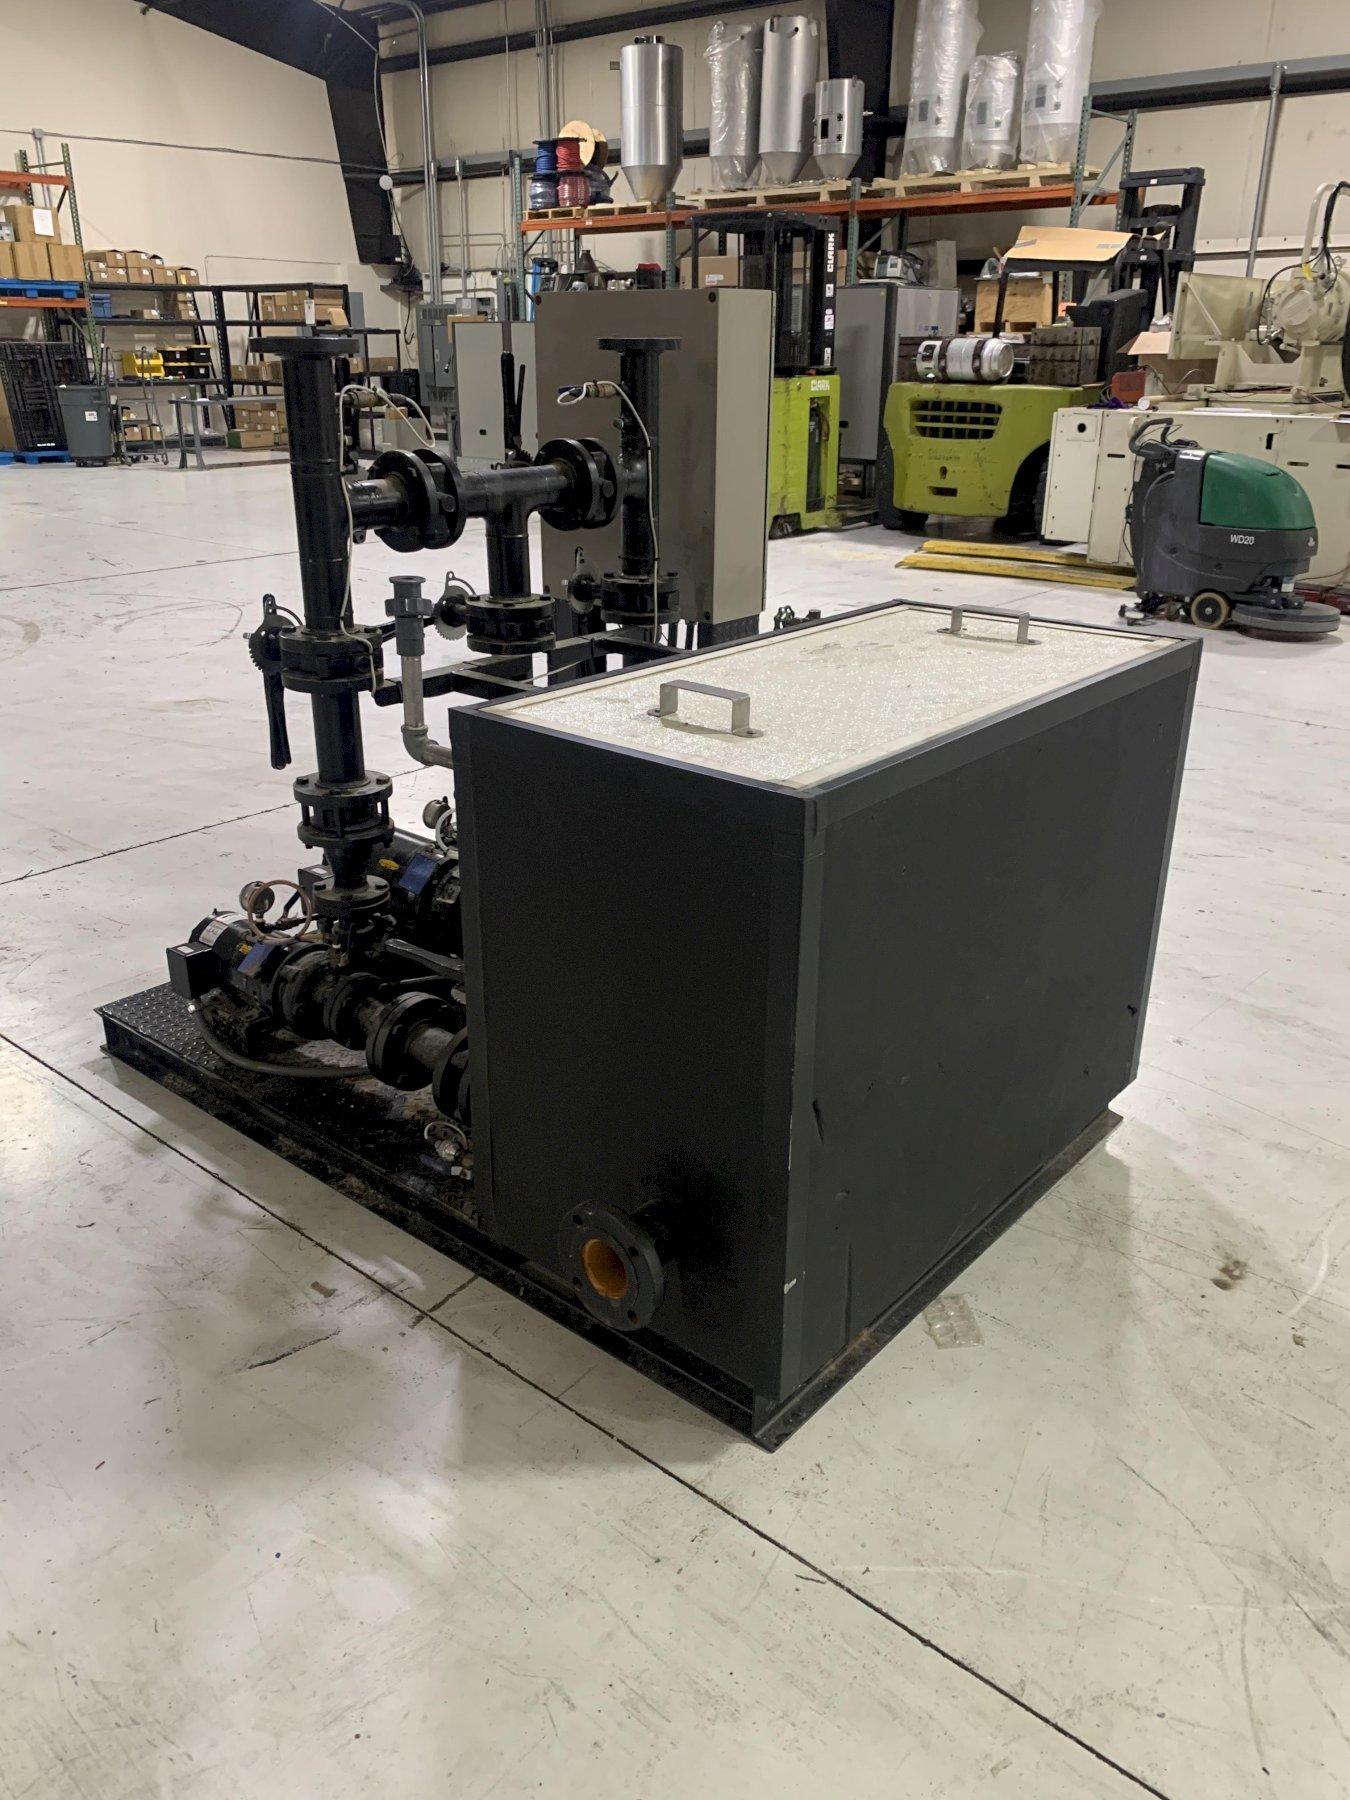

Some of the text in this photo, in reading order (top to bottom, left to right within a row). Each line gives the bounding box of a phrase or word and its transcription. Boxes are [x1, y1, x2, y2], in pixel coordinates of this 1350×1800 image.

[827, 233, 835, 272] CLARK
[810, 379, 830, 391] CLARK
[1230, 534, 1255, 545] WD20
